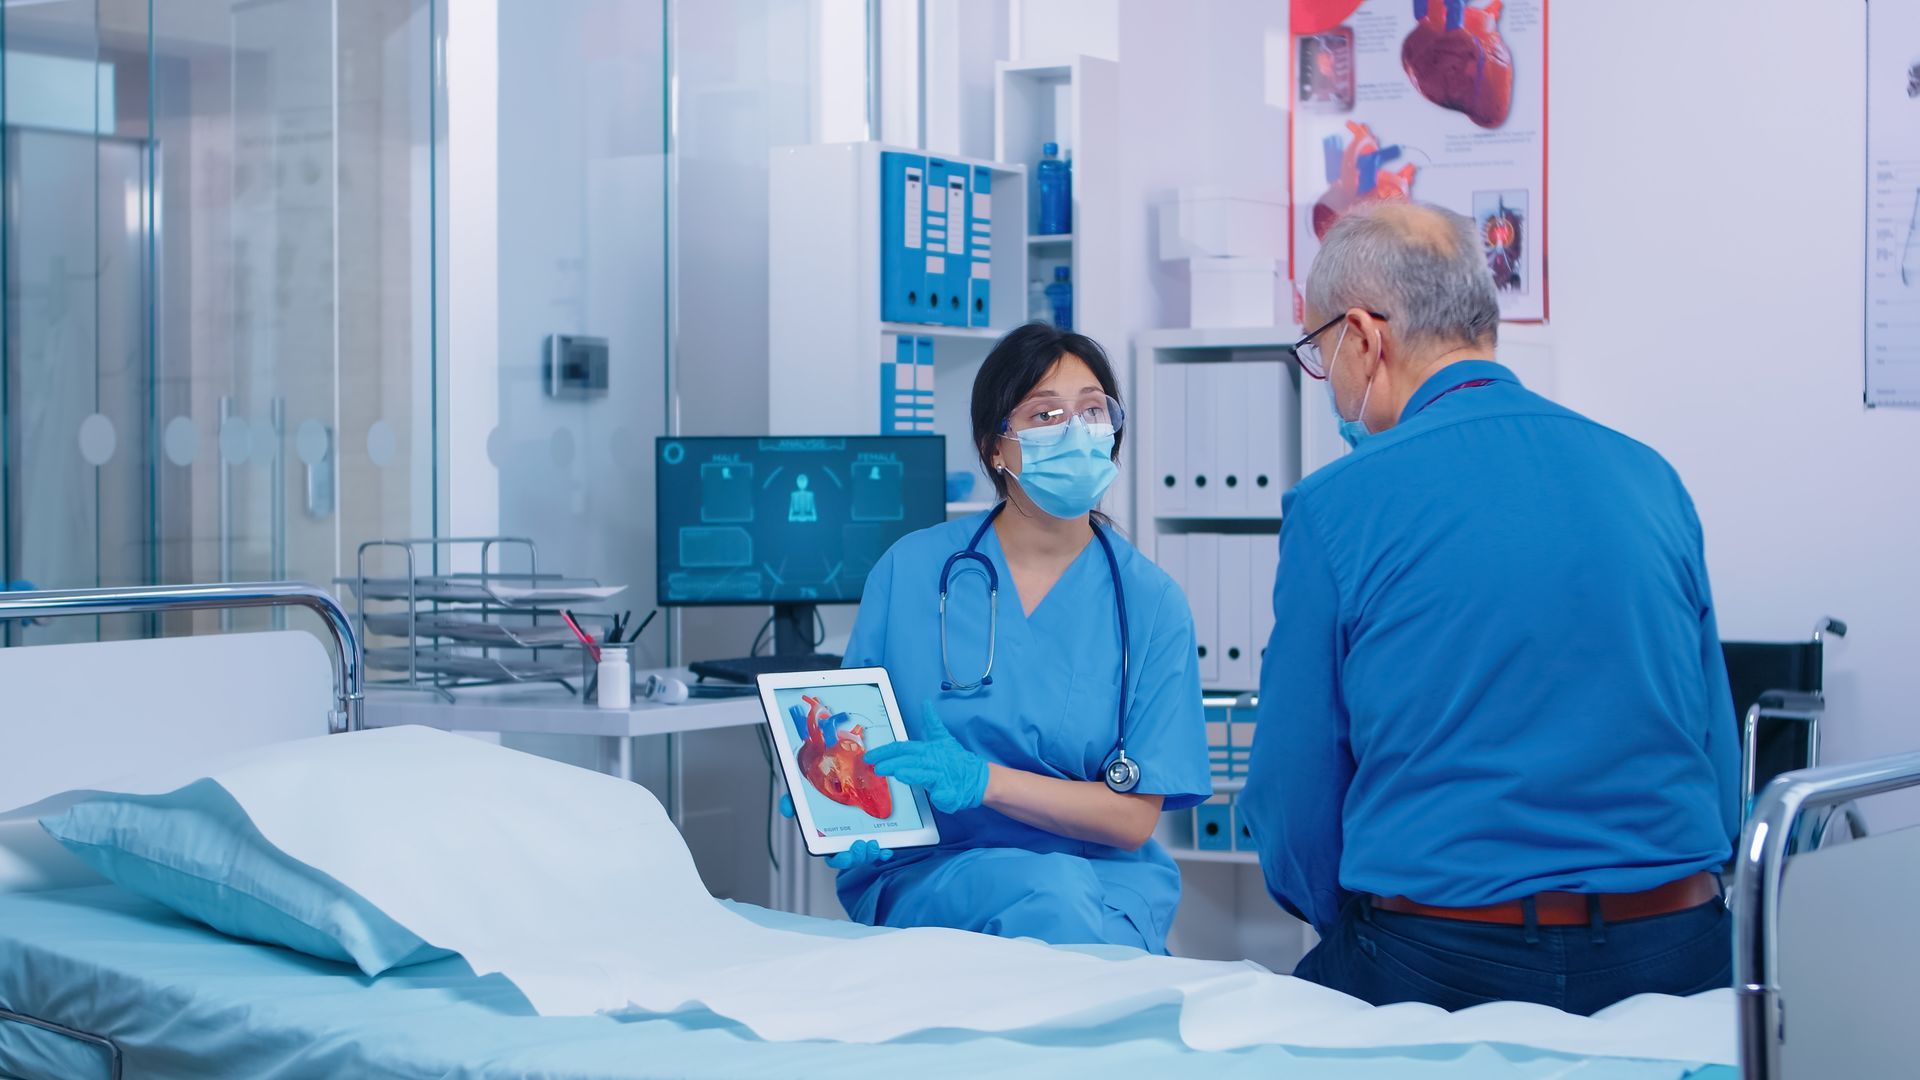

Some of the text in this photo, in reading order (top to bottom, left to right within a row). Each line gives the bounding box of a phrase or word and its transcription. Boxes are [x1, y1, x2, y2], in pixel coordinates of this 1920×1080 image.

[778, 439, 826, 449] ANALYSIS
[712, 454, 740, 463] MALE
[857, 453, 896, 462] FEMALE
